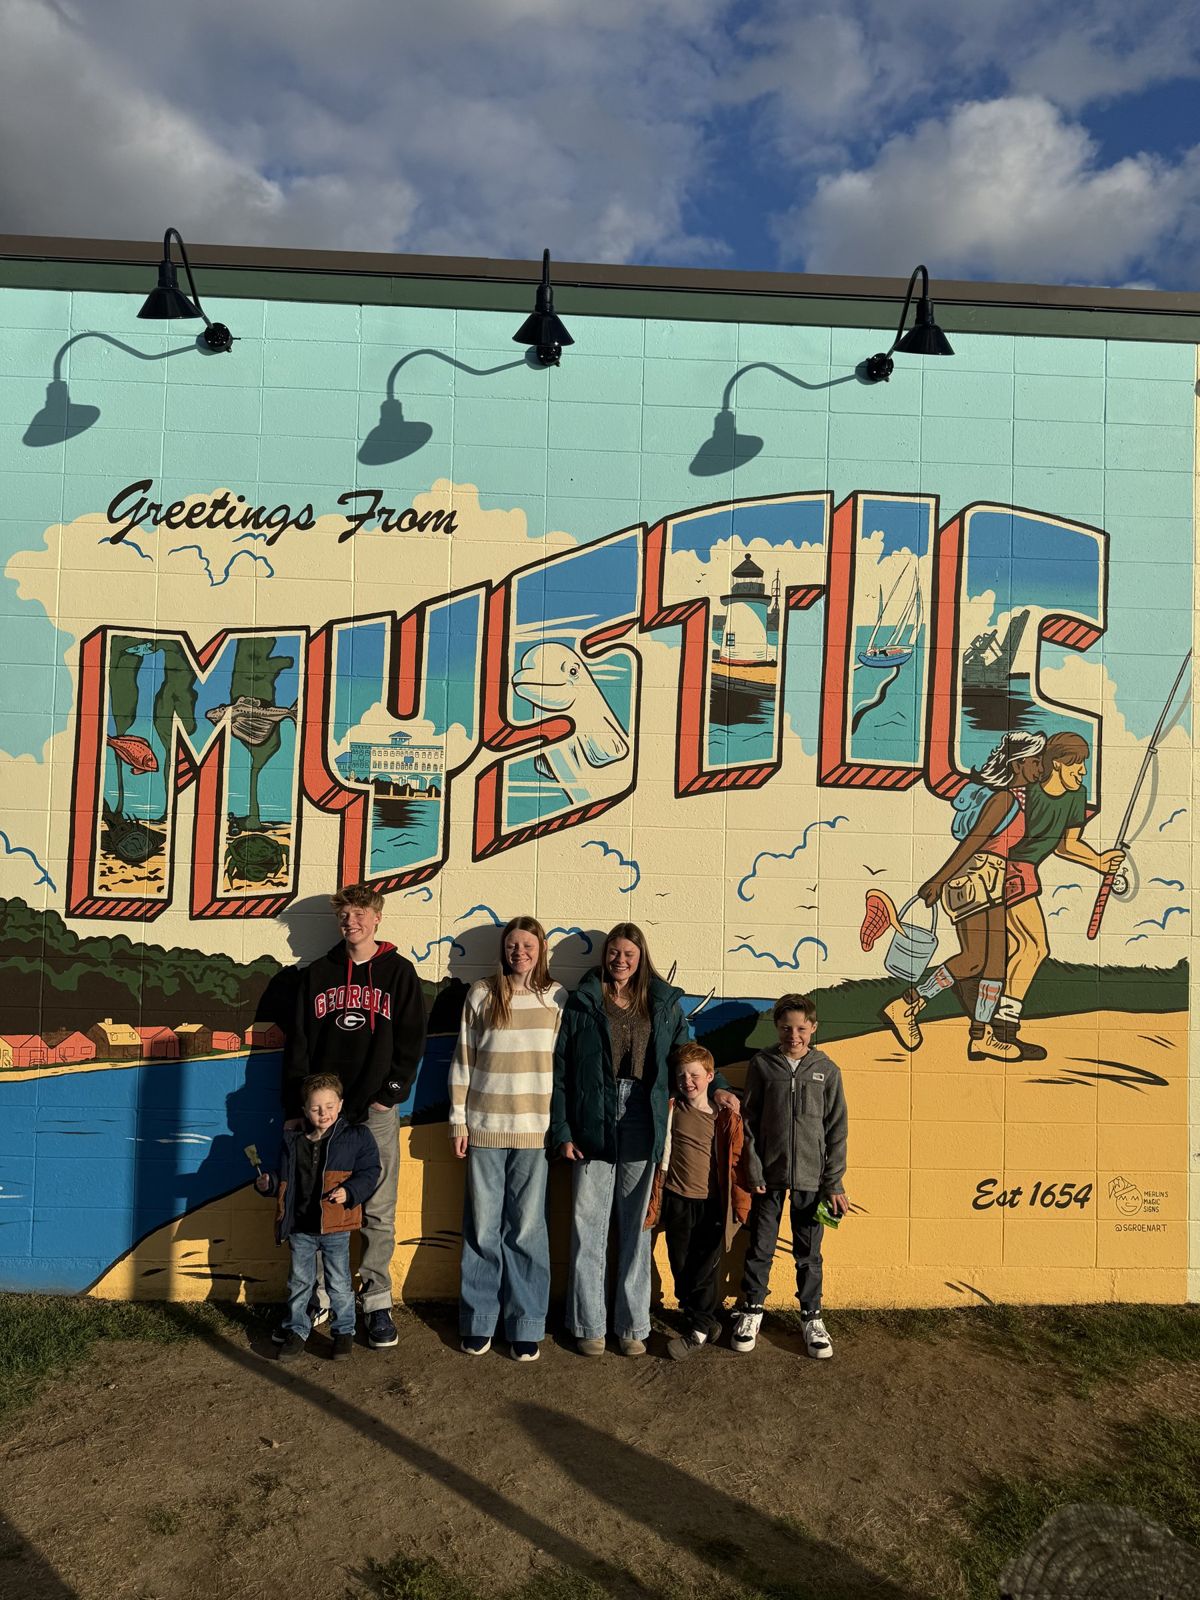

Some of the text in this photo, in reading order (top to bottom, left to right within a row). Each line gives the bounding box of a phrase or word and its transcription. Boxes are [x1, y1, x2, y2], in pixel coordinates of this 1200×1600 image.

[106, 478, 460, 546] Greetings From
[66, 489, 1110, 922] MYSTIC
[314, 984, 392, 1020] GEORGIA
[971, 1178, 1093, 1210] Est 1654
[1143, 1198, 1161, 1206] MAGIC
[1143, 1205, 1160, 1213] SIGNS
